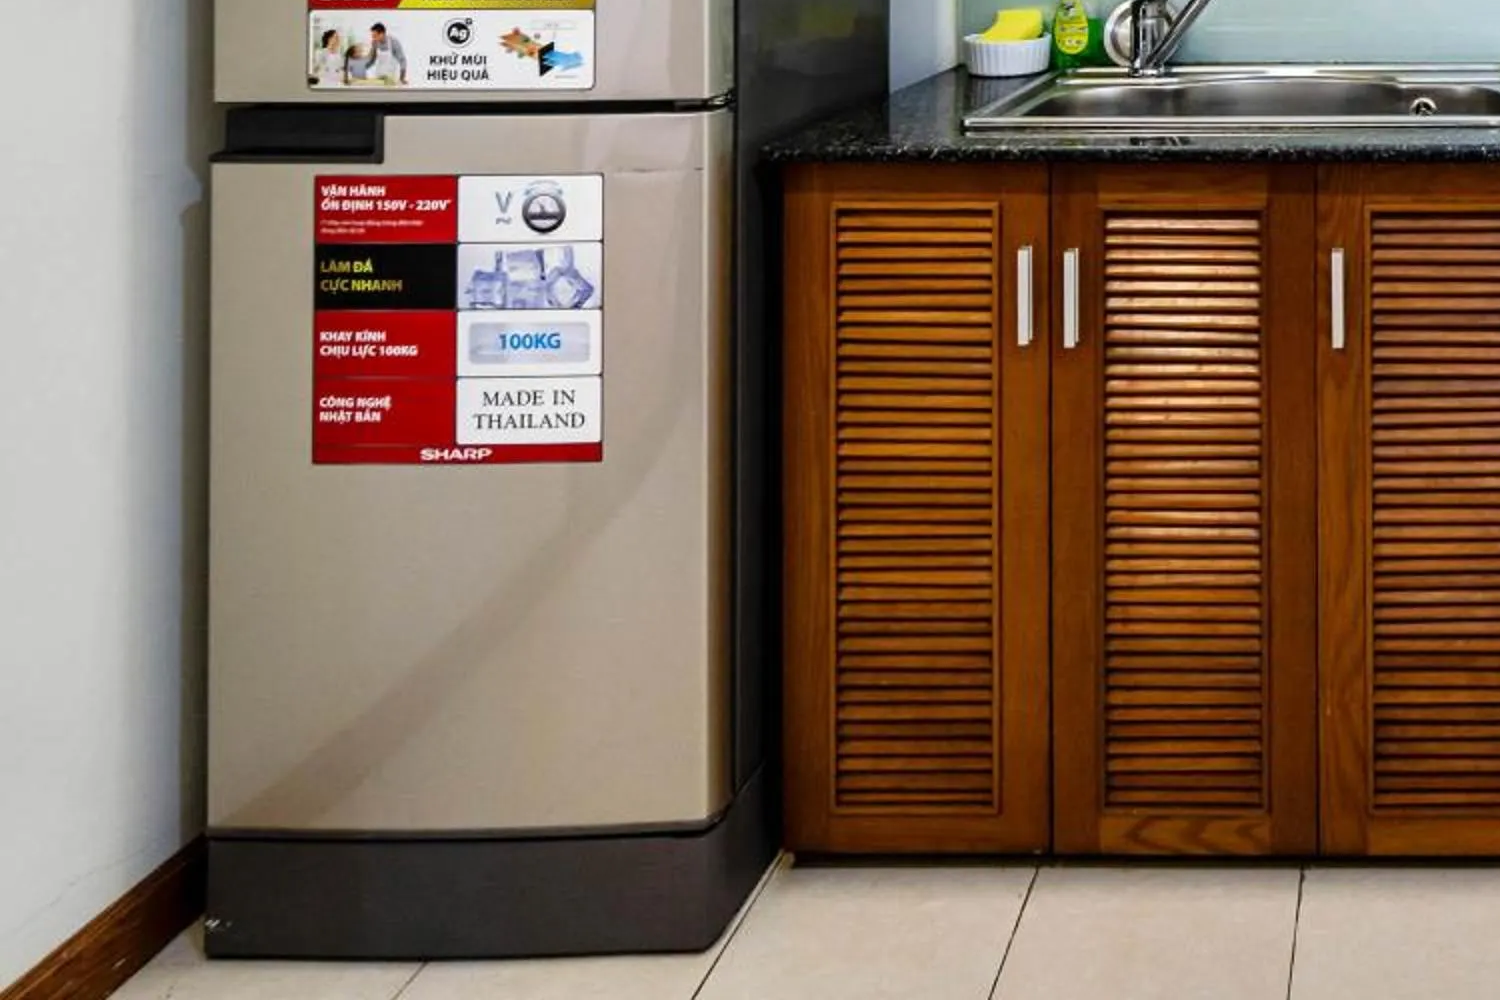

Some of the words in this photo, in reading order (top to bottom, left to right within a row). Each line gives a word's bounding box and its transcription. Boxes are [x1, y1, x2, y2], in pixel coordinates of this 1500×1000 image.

[376, 200, 407, 211] 150V
[495, 191, 512, 214] V
[351, 279, 403, 292] NHANH
[319, 331, 352, 342] KHAY
[499, 333, 562, 350] 100KG
[379, 345, 418, 356] 100KG
[483, 390, 544, 407] MADE
[553, 390, 576, 406] IN
[473, 413, 585, 430] THAILAND
[419, 449, 493, 461] SHARP
